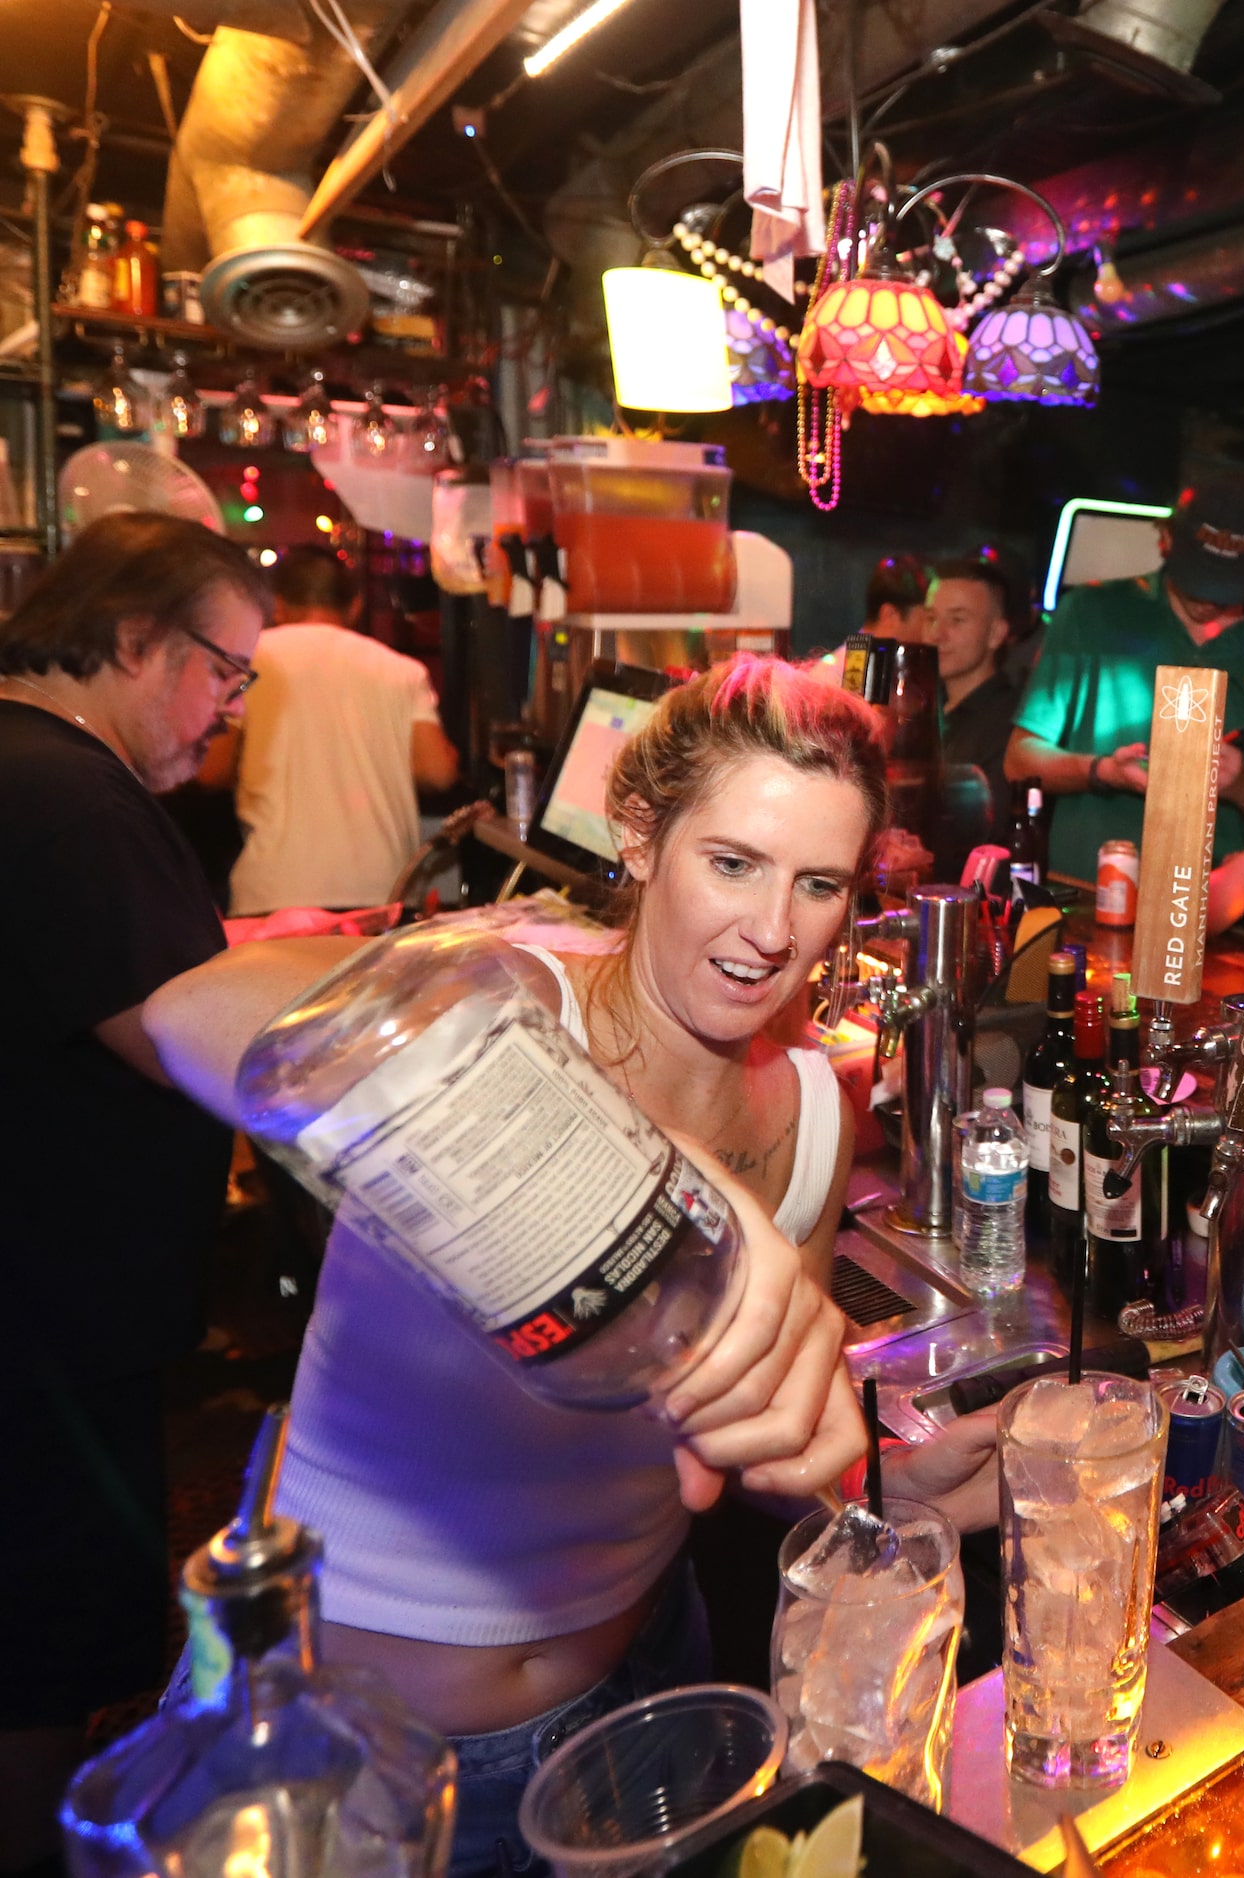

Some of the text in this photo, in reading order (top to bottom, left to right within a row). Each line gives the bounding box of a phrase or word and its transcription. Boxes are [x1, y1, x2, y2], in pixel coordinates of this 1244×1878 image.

[1195, 716, 1223, 967] MANHATTAN PROJECT
[1164, 865, 1192, 986] RED GATE
[514, 1150, 543, 1179] MEXICO
[603, 1219, 664, 1286] SAN NICOLAS
[613, 1227, 672, 1293] DESTILADORA
[1164, 1475, 1206, 1498] Red
